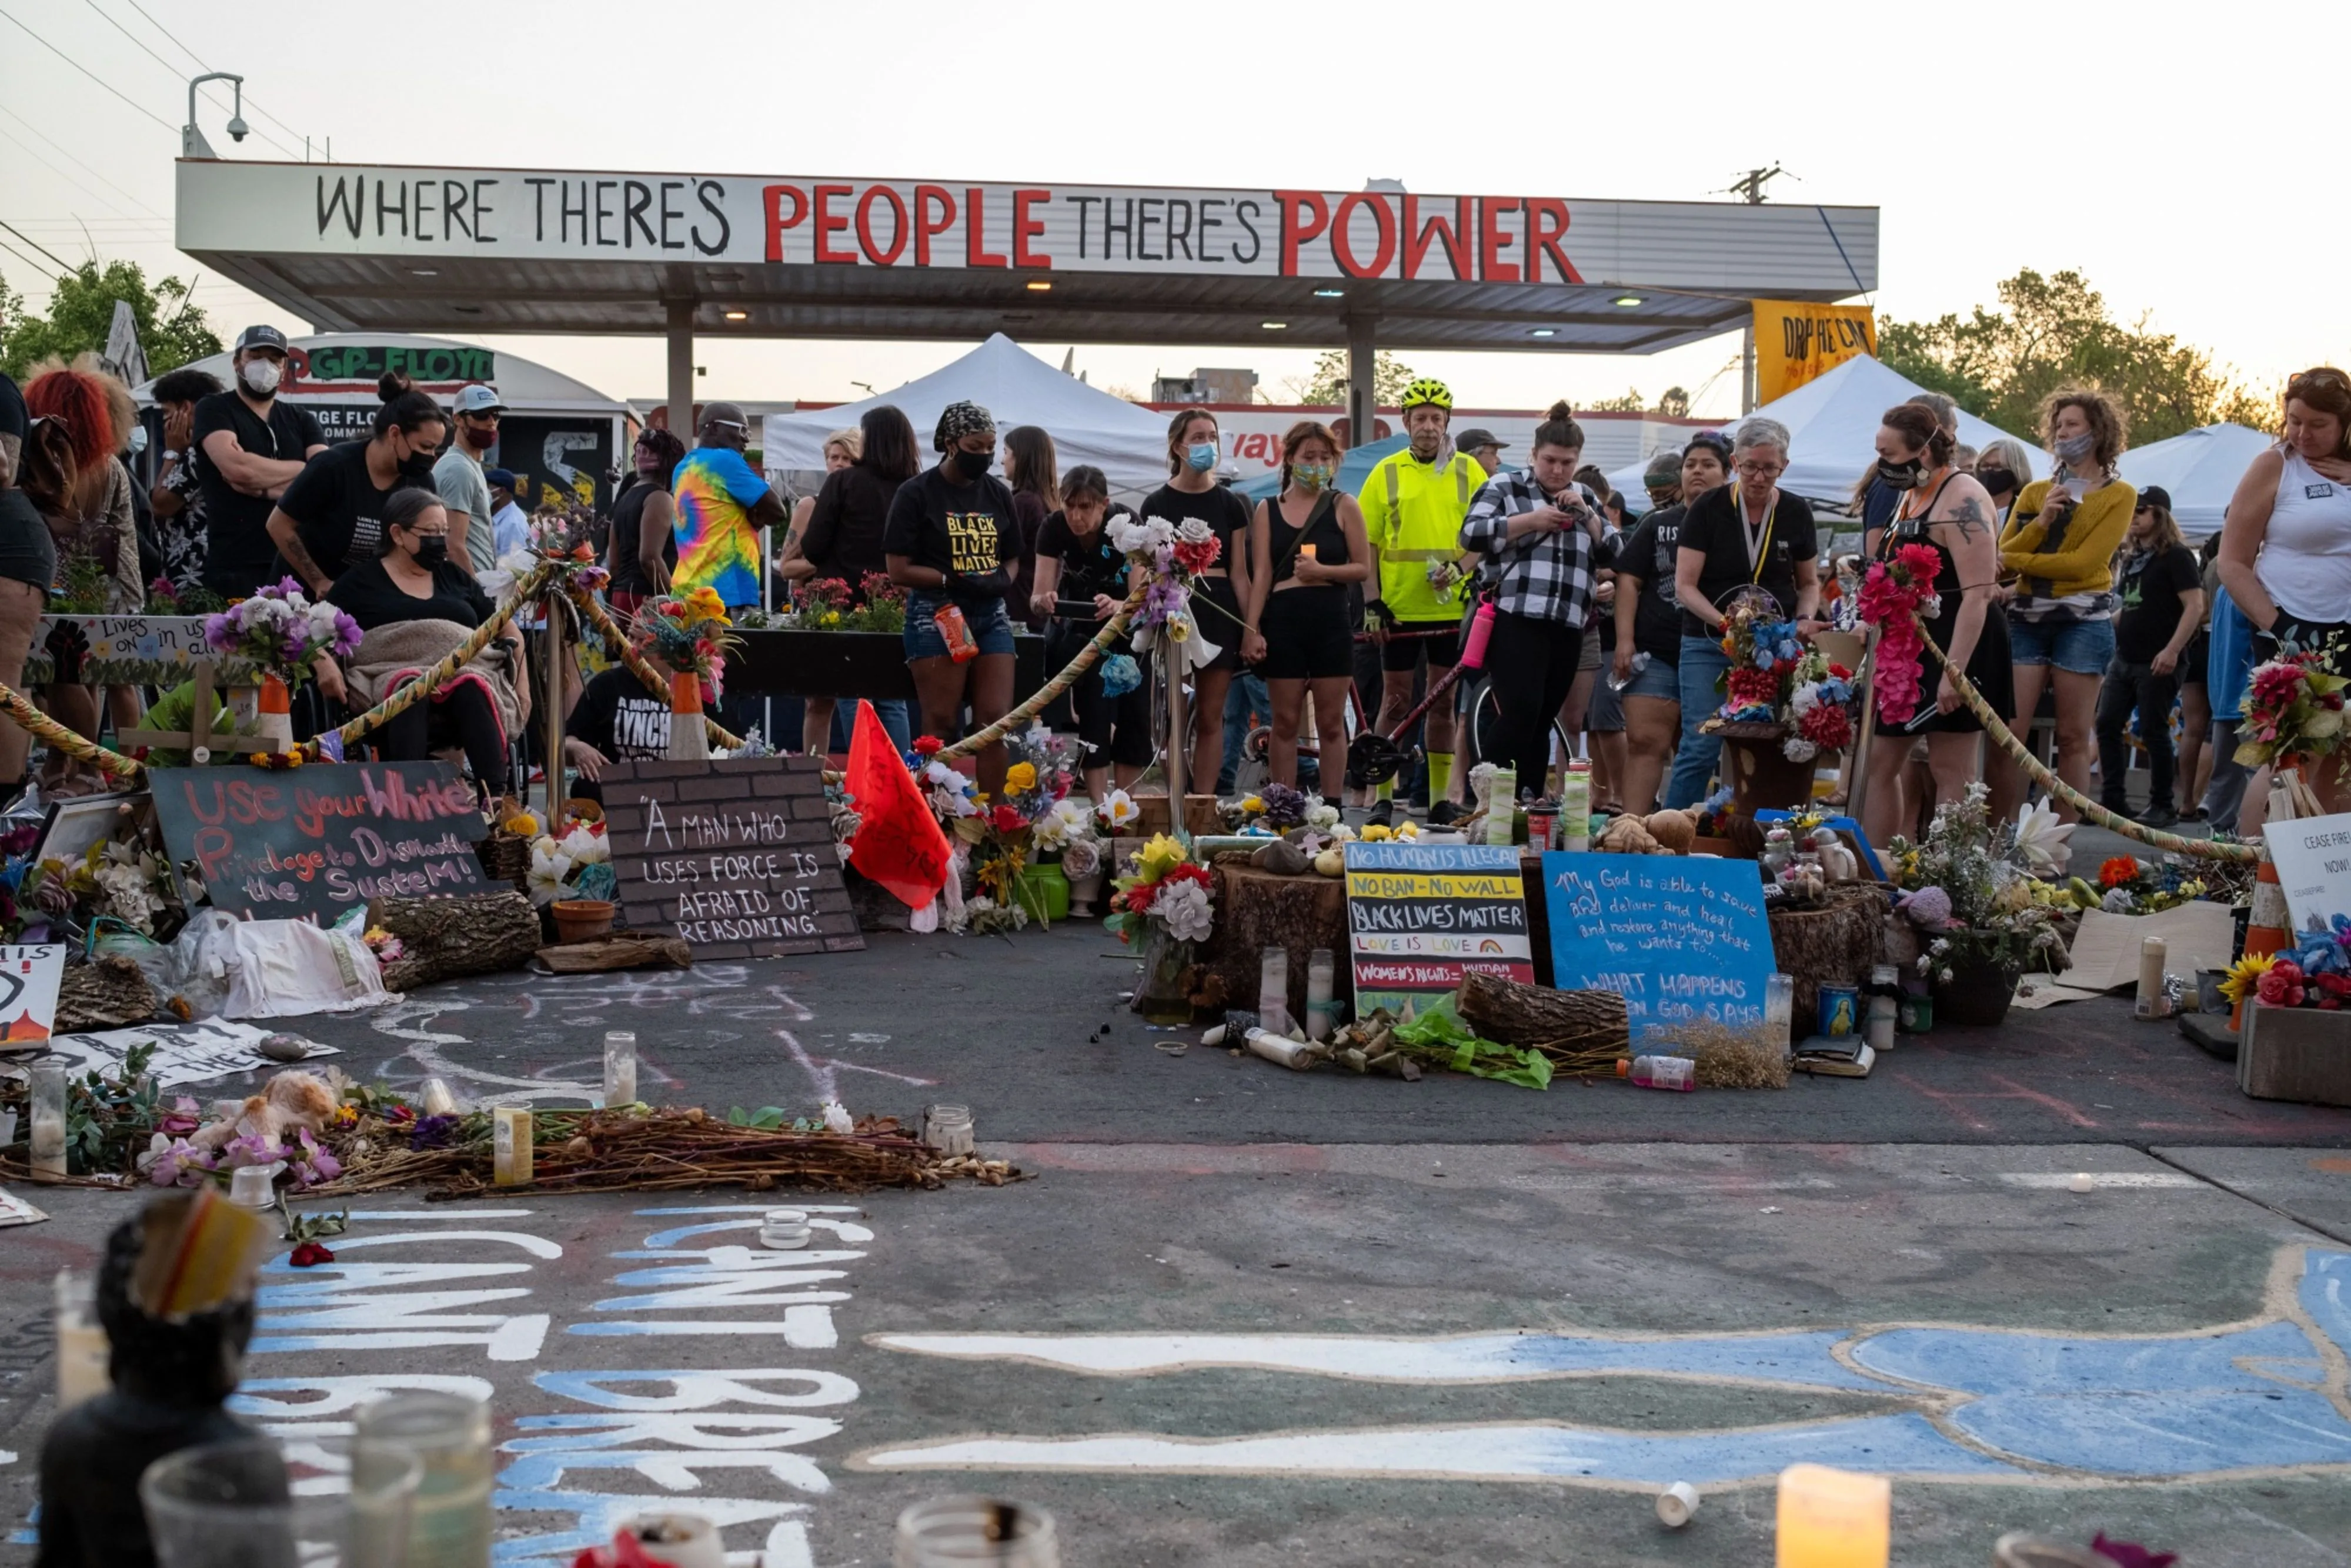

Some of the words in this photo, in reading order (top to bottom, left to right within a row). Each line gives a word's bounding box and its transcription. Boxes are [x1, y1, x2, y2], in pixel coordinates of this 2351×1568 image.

[316, 175, 499, 242] WHERE
[524, 177, 730, 256] THERE'S
[763, 185, 1052, 269] PEOPLE
[1066, 195, 1261, 264] THERE'S
[1273, 189, 1585, 284] POWER
[947, 517, 996, 531] BLACK
[951, 537, 997, 555] LIVES
[157, 627, 178, 648] in
[618, 696, 627, 709] A
[629, 698, 660, 711] MAN
[294, 787, 366, 838] your
[682, 814, 729, 847] MAN
[736, 811, 786, 842] WHO
[2305, 834, 2332, 850] CEASE
[643, 860, 699, 883] USES
[710, 854, 781, 881] FORCE
[789, 852, 820, 879] IS
[1352, 846, 1375, 868] NO
[1381, 847, 1438, 868] HUMAN
[1441, 847, 1456, 868] IS
[1461, 848, 1518, 868] ILLEGAL
[242, 874, 299, 902] the
[1354, 877, 1380, 895] NO
[1382, 878, 1415, 898] BAN
[1429, 878, 1453, 897] NO
[1458, 879, 1517, 895] WALL
[1600, 868, 1631, 891] God
[1639, 874, 1654, 889] is
[1659, 877, 1696, 893] able
[1700, 881, 1715, 898] to
[1721, 891, 1757, 918] save
[679, 889, 770, 918] AFRAID
[782, 887, 810, 912] OF
[1609, 897, 1657, 915] deliver
[1664, 900, 1691, 918] and
[1352, 901, 1404, 932] BLACK
[1404, 905, 1454, 929] LIVES
[1459, 906, 1524, 928] MATTER
[1356, 937, 1400, 951] LOVE
[1407, 937, 1421, 950] IS
[1432, 939, 1471, 952] LOVE
[1579, 919, 1606, 938] and
[1610, 918, 1656, 934] restore
[1661, 918, 1715, 944] anything
[1718, 932, 1752, 952] that
[1605, 939, 1628, 953] he
[1638, 935, 1682, 951] wants
[1582, 973, 1645, 995] WHAT
[1660, 974, 1746, 999] HAPPENS
[1658, 998, 1694, 1018] GOD
